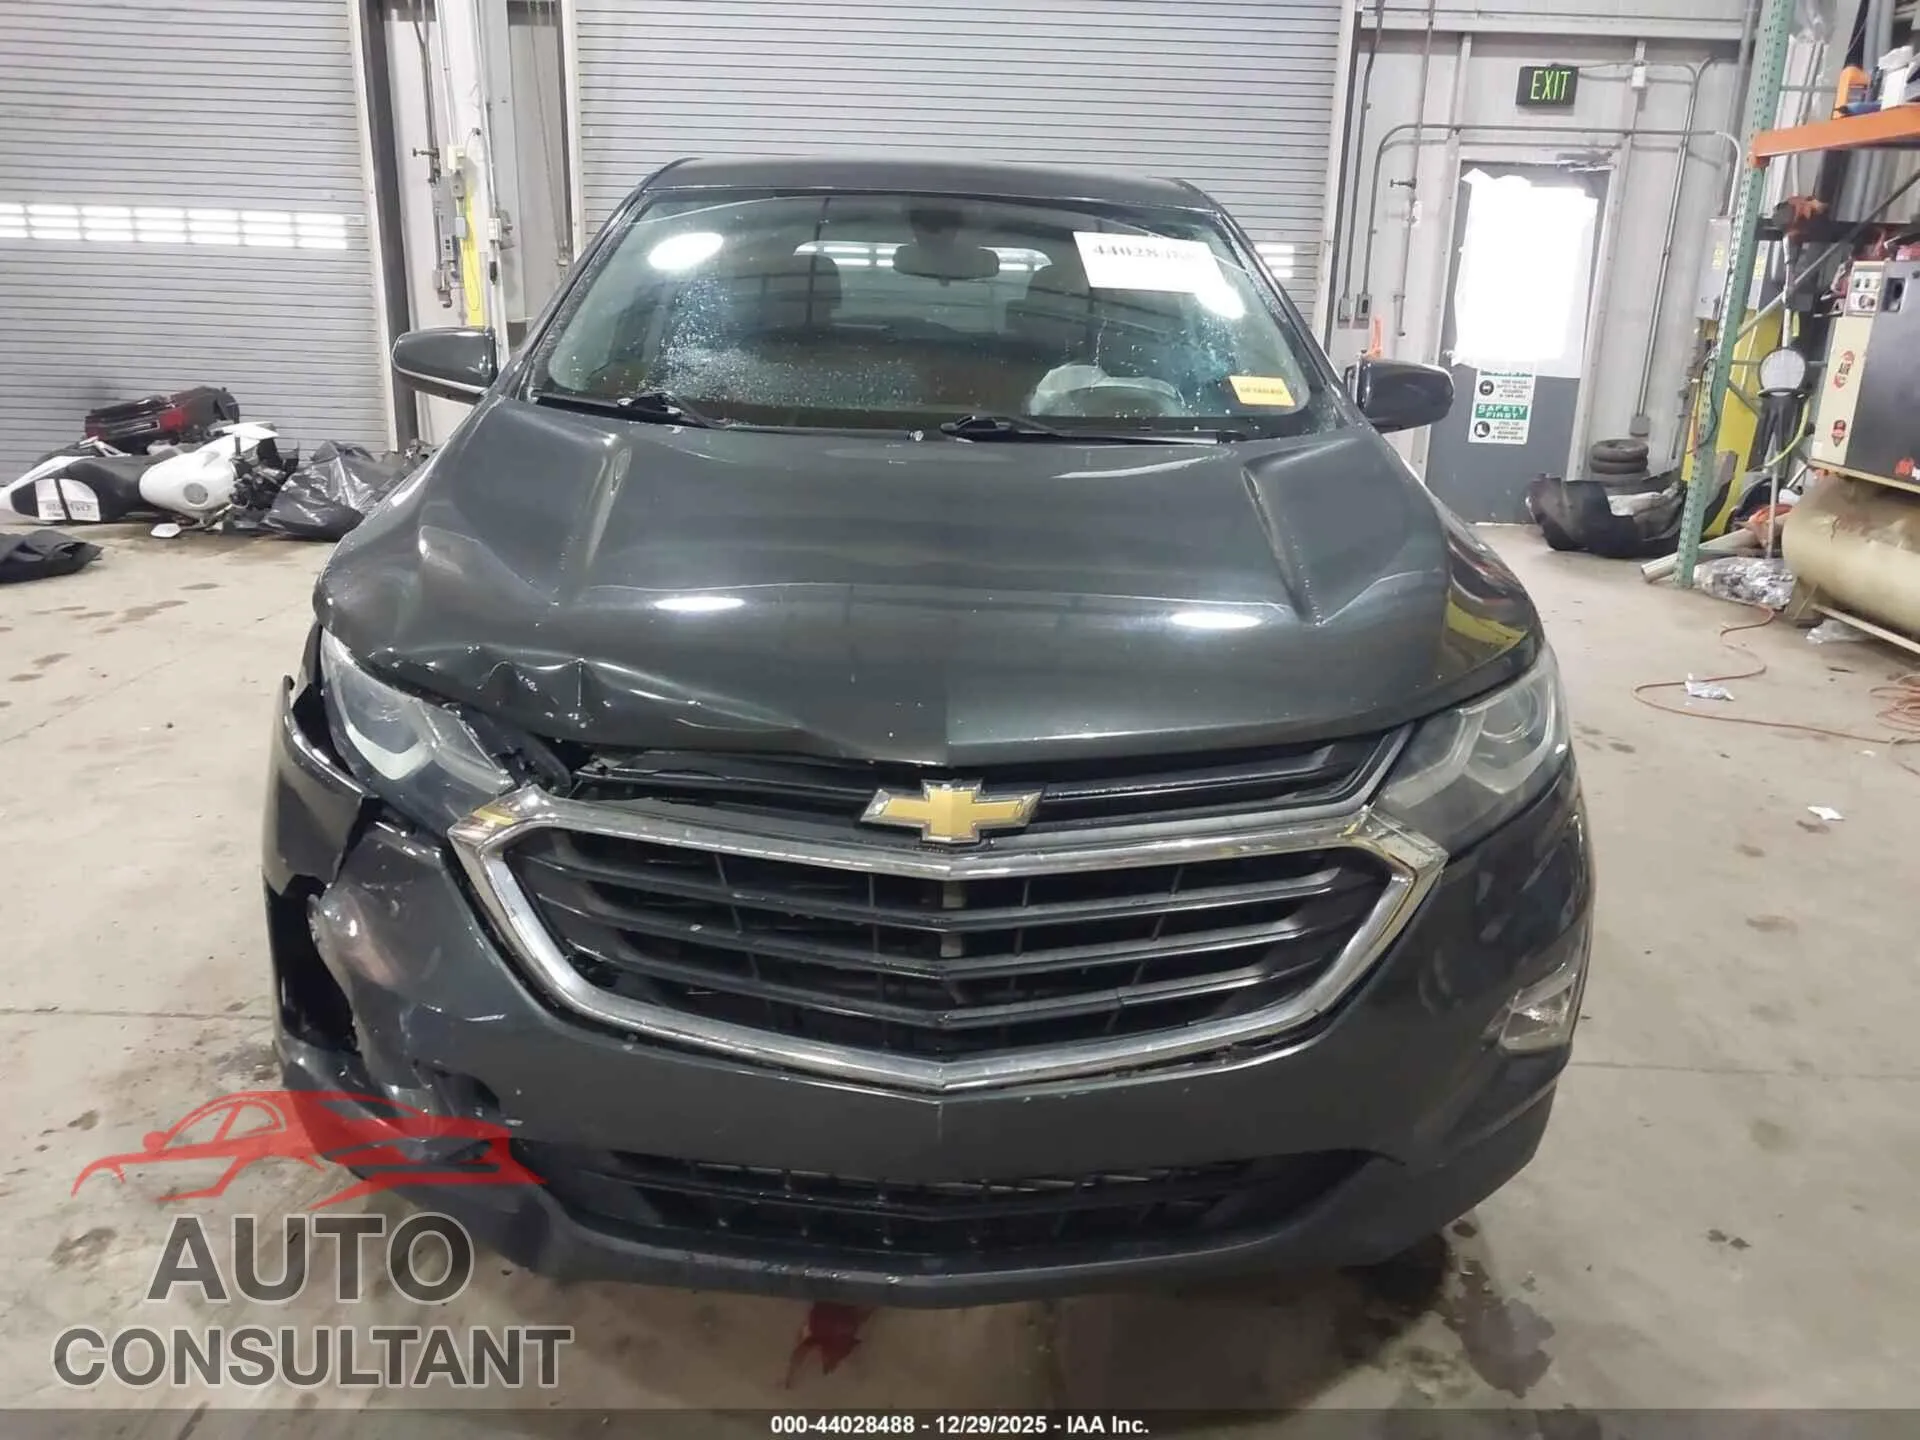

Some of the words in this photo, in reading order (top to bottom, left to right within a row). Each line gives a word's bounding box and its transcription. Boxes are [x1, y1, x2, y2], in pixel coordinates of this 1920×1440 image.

[1530, 70, 1571, 101] EXIT
[1478, 404, 1525, 415] SAFETY
[1486, 411, 1519, 419] FIRST
